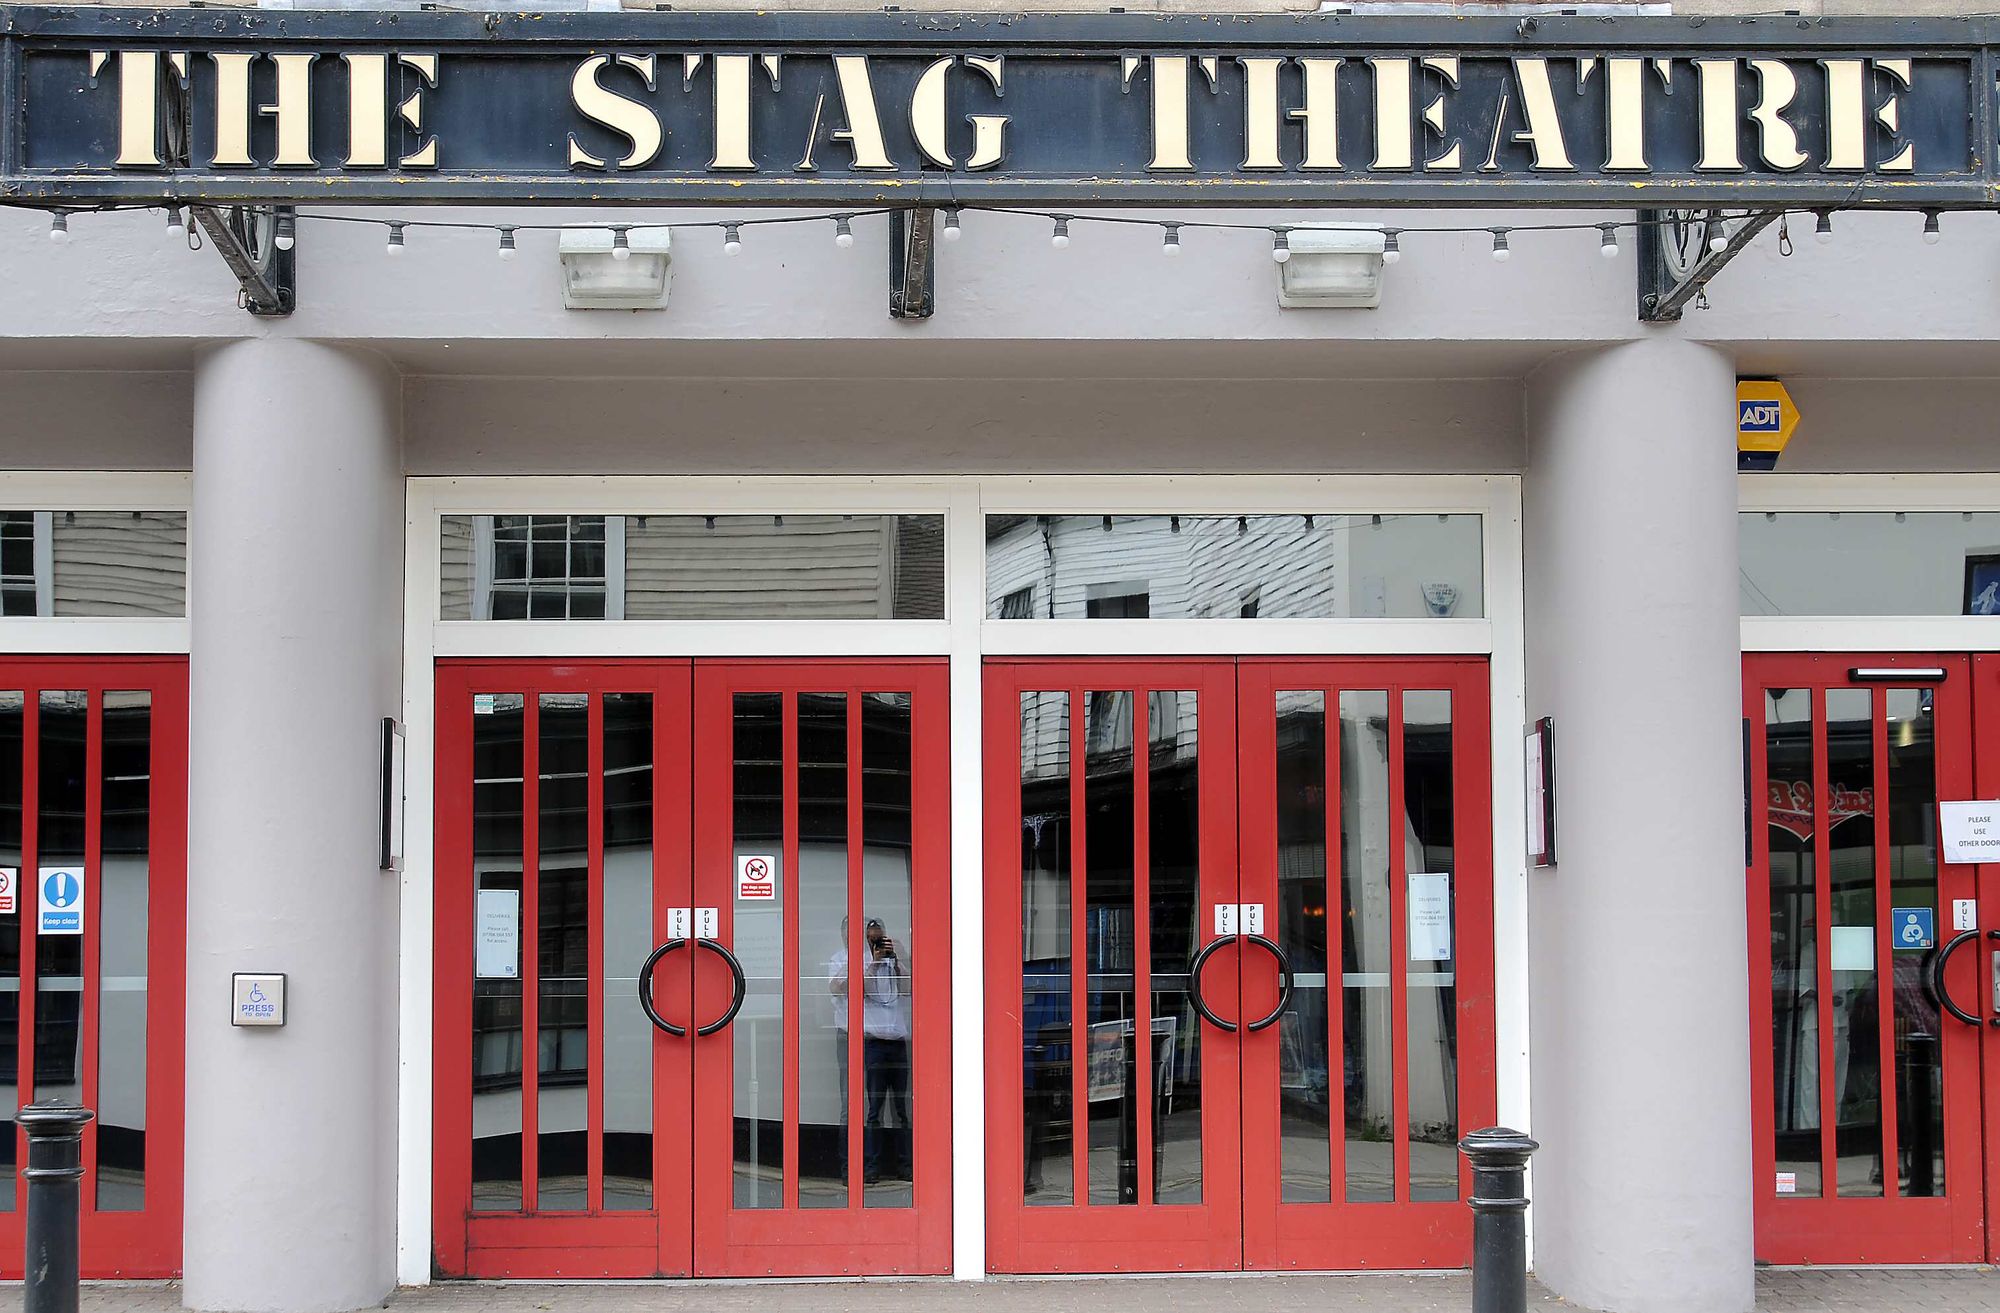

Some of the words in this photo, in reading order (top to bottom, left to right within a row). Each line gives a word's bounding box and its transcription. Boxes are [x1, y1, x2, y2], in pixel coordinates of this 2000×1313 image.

[89, 51, 440, 169] THE
[567, 53, 1012, 171] STAG
[1120, 54, 1915, 172] THEATRE
[1740, 406, 1780, 425] ADT
[1968, 815, 1992, 823] PLEASE
[44, 917, 61, 926] Keep
[62, 917, 79, 925] clear
[241, 1004, 275, 1012] PRESS
